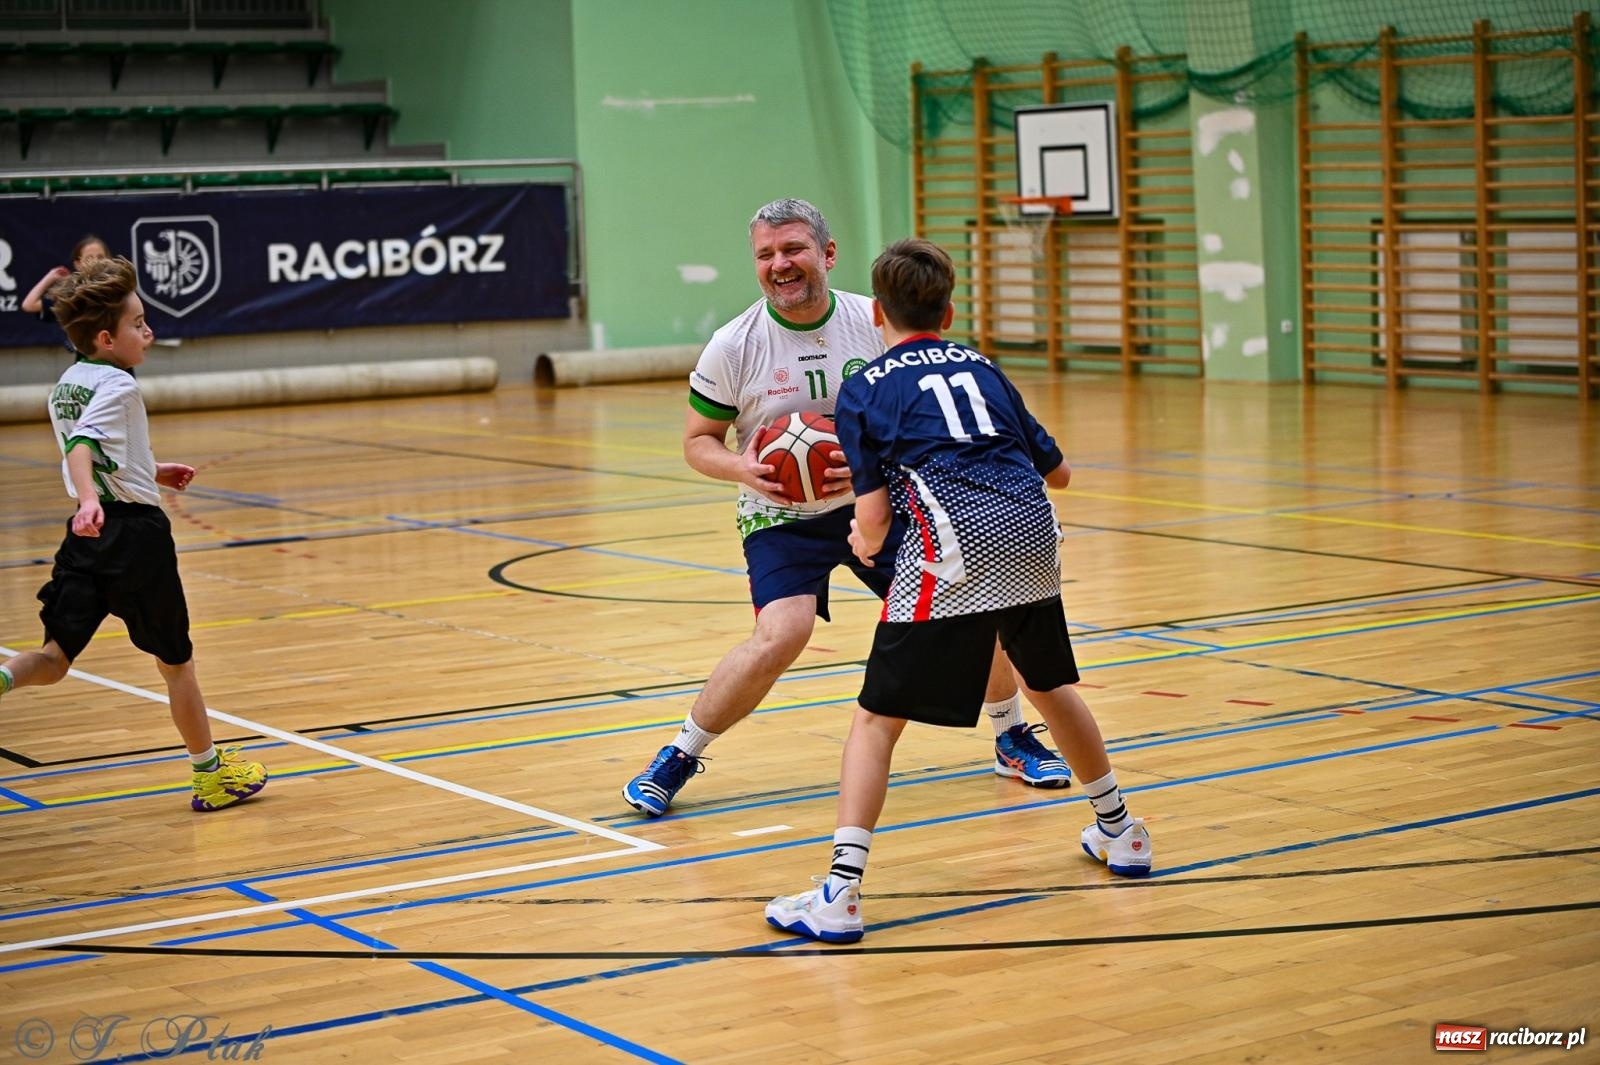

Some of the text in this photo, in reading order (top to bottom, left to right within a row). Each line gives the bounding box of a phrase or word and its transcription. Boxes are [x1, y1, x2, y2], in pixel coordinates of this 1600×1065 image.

[267, 224, 507, 283] RACIBÓRZ
[767, 387, 800, 396] Racibórz
[804, 369, 828, 400] 11
[918, 371, 1000, 443] 11
